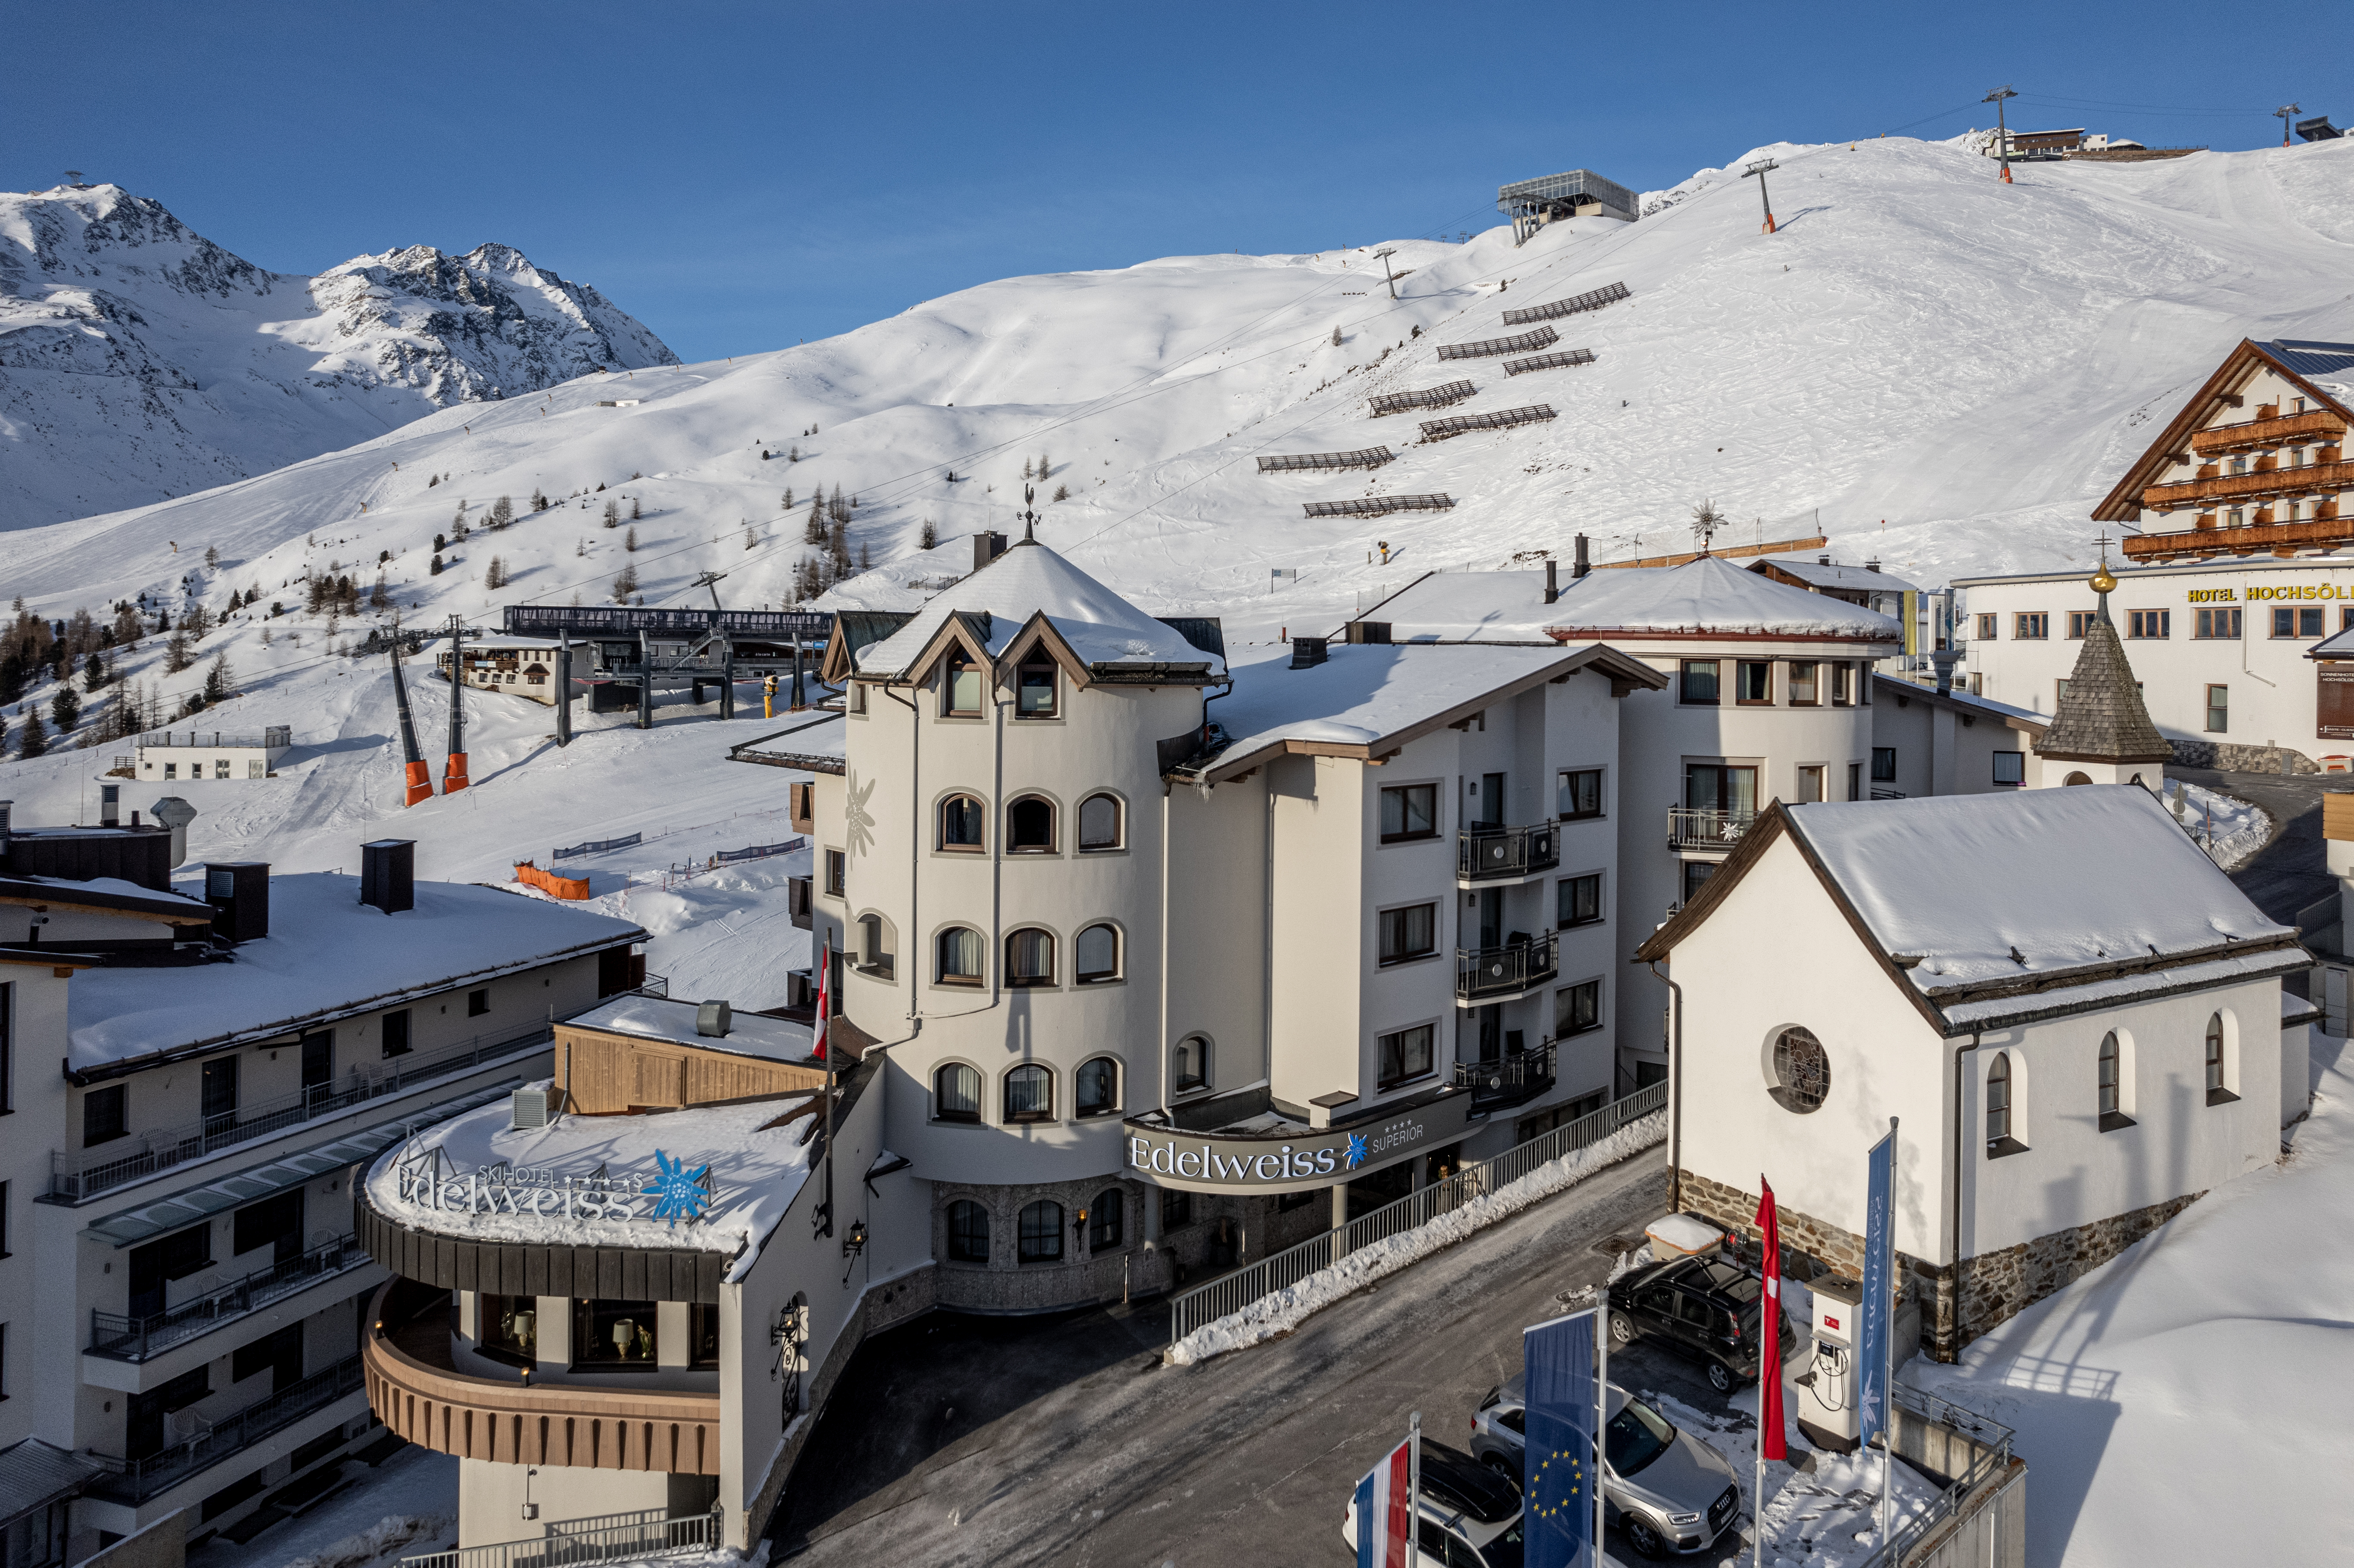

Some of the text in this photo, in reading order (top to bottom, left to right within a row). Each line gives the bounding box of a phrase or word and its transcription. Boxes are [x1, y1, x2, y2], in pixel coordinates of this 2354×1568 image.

[2188, 588, 2236, 602] HOTEL
[1373, 1124, 1423, 1154] SUPERIOR
[1130, 1136, 1336, 1180] Edelweiss
[479, 1165, 560, 1184] SKIHOTEL
[396, 1163, 634, 1222] Edelweiss
